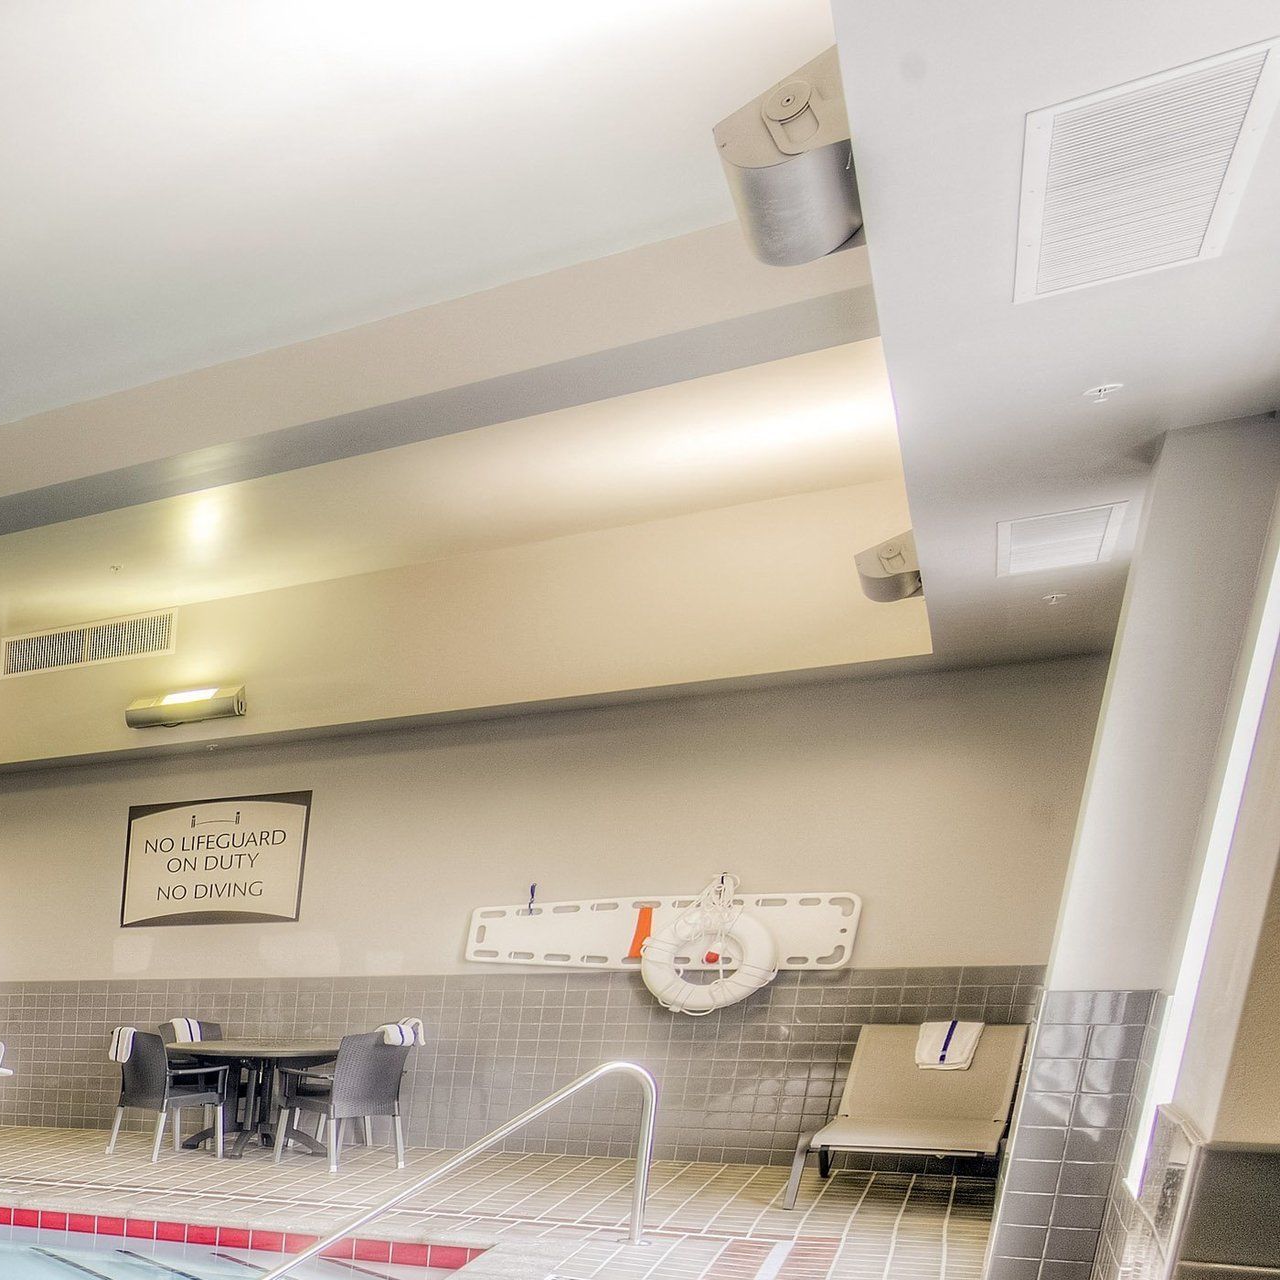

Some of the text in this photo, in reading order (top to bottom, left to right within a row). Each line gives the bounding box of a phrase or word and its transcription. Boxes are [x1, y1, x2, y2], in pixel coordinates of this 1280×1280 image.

[144, 829, 287, 854] NO LIFEGUARD
[166, 852, 260, 873] ON DUTY
[157, 881, 264, 901] NO DIVING
